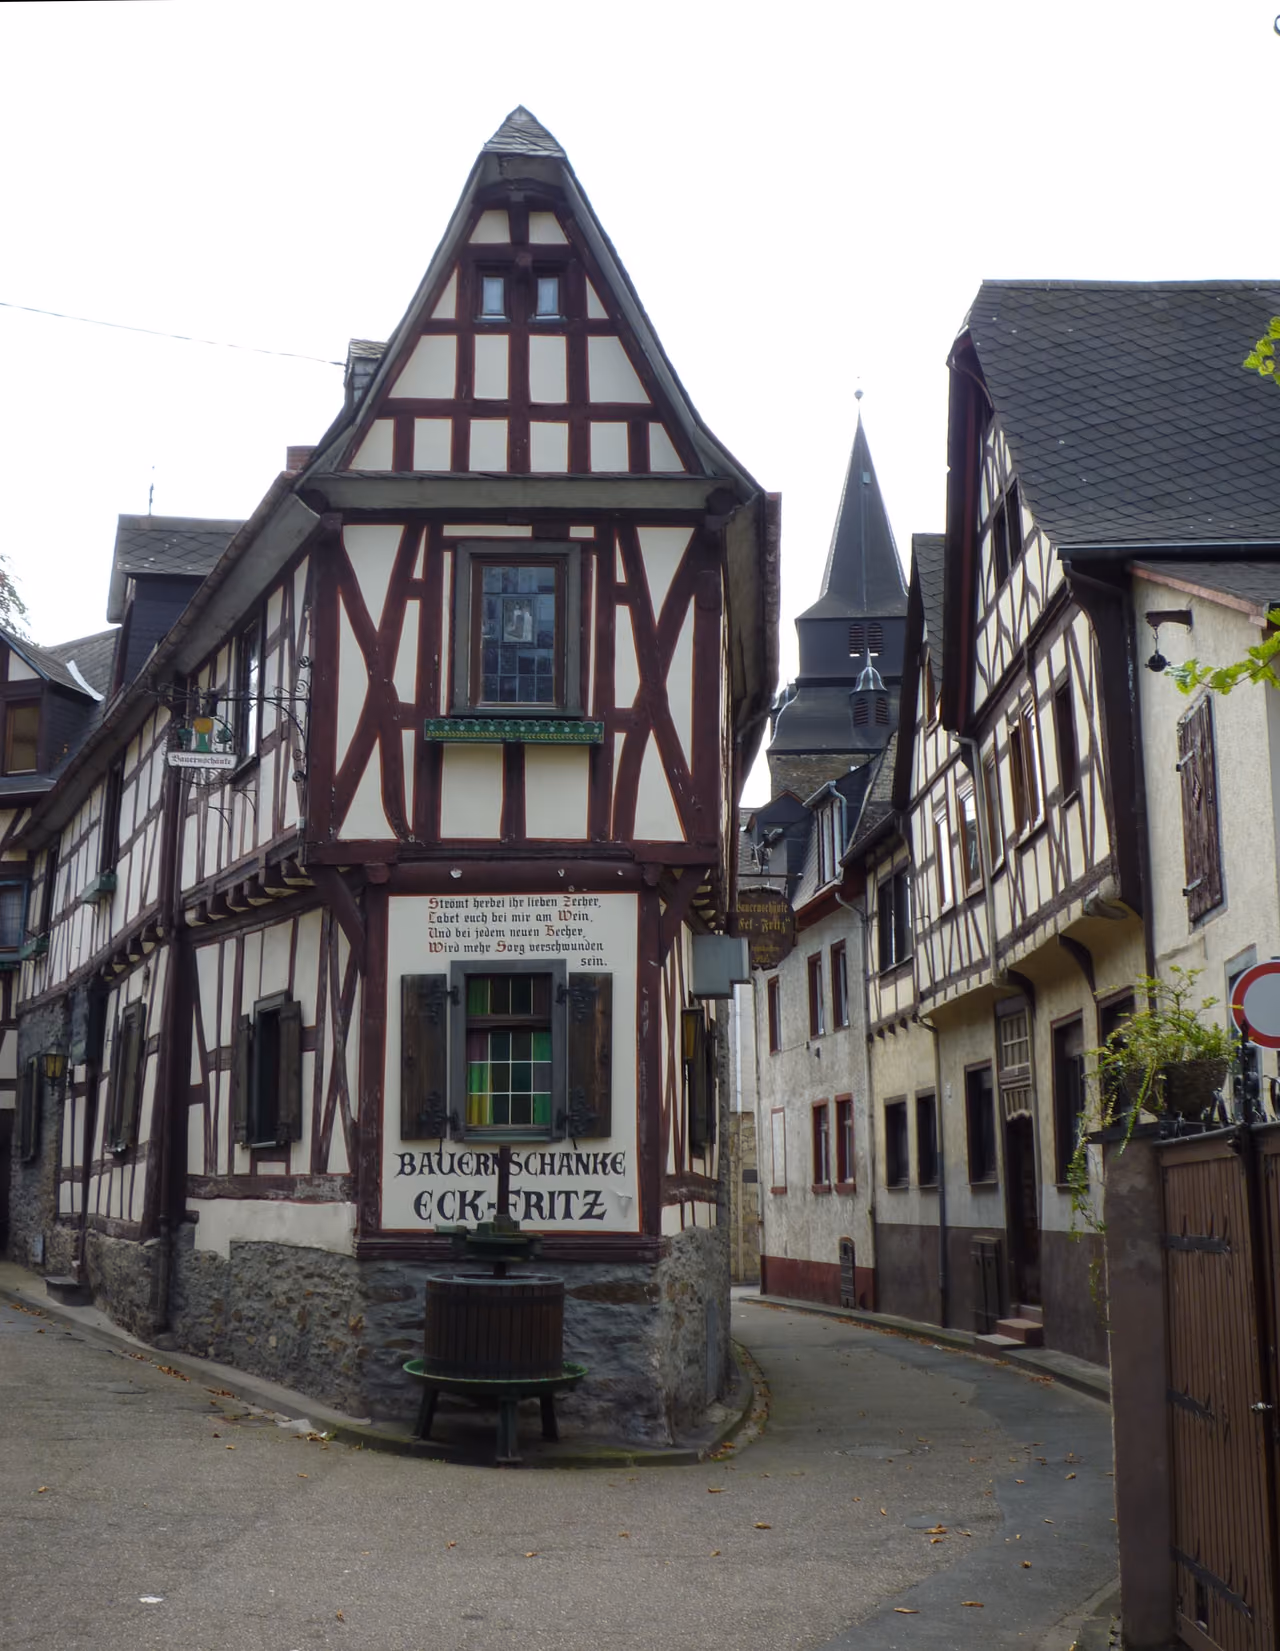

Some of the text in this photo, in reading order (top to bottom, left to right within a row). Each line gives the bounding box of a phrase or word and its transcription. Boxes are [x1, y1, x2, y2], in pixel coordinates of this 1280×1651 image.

[171, 754, 231, 765] Bauernschänke
[428, 897, 469, 910] Strömt
[473, 897, 505, 911] herbei
[509, 896, 524, 910] ihr
[527, 896, 558, 908] lieben
[428, 911, 459, 924] Labet
[464, 912, 488, 925] euch
[491, 911, 507, 923] bei
[512, 911, 531, 922] mir
[535, 913, 552, 922] am
[428, 927, 451, 939] Und
[455, 927, 471, 938] bei
[475, 927, 506, 940] jedem
[510, 927, 539, 938] neuen
[428, 938, 604, 956] Wird mehr Sorg verschwunden
[580, 955, 608, 967] sein.
